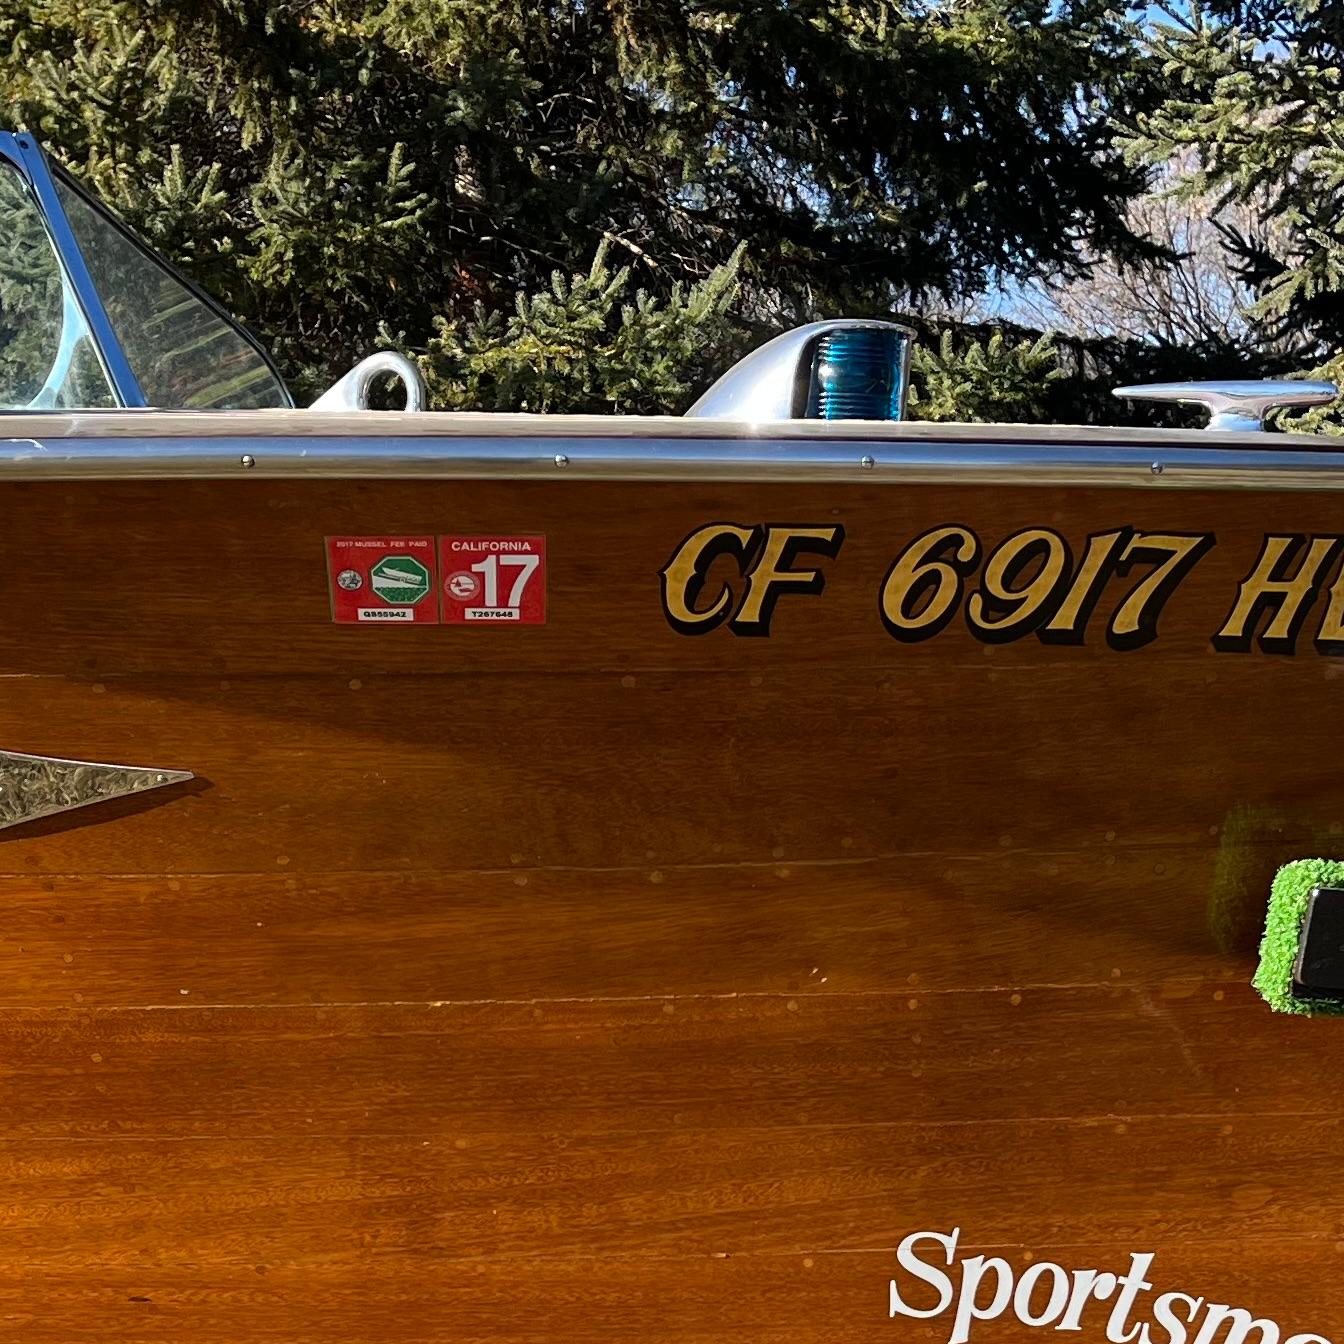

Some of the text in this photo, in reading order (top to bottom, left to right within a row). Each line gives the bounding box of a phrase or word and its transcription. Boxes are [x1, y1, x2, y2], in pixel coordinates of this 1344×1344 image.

[451, 541, 532, 552] CALIFORNIA
[471, 554, 540, 607] 17
[659, 523, 846, 636] CF
[878, 526, 1217, 652] 6917
